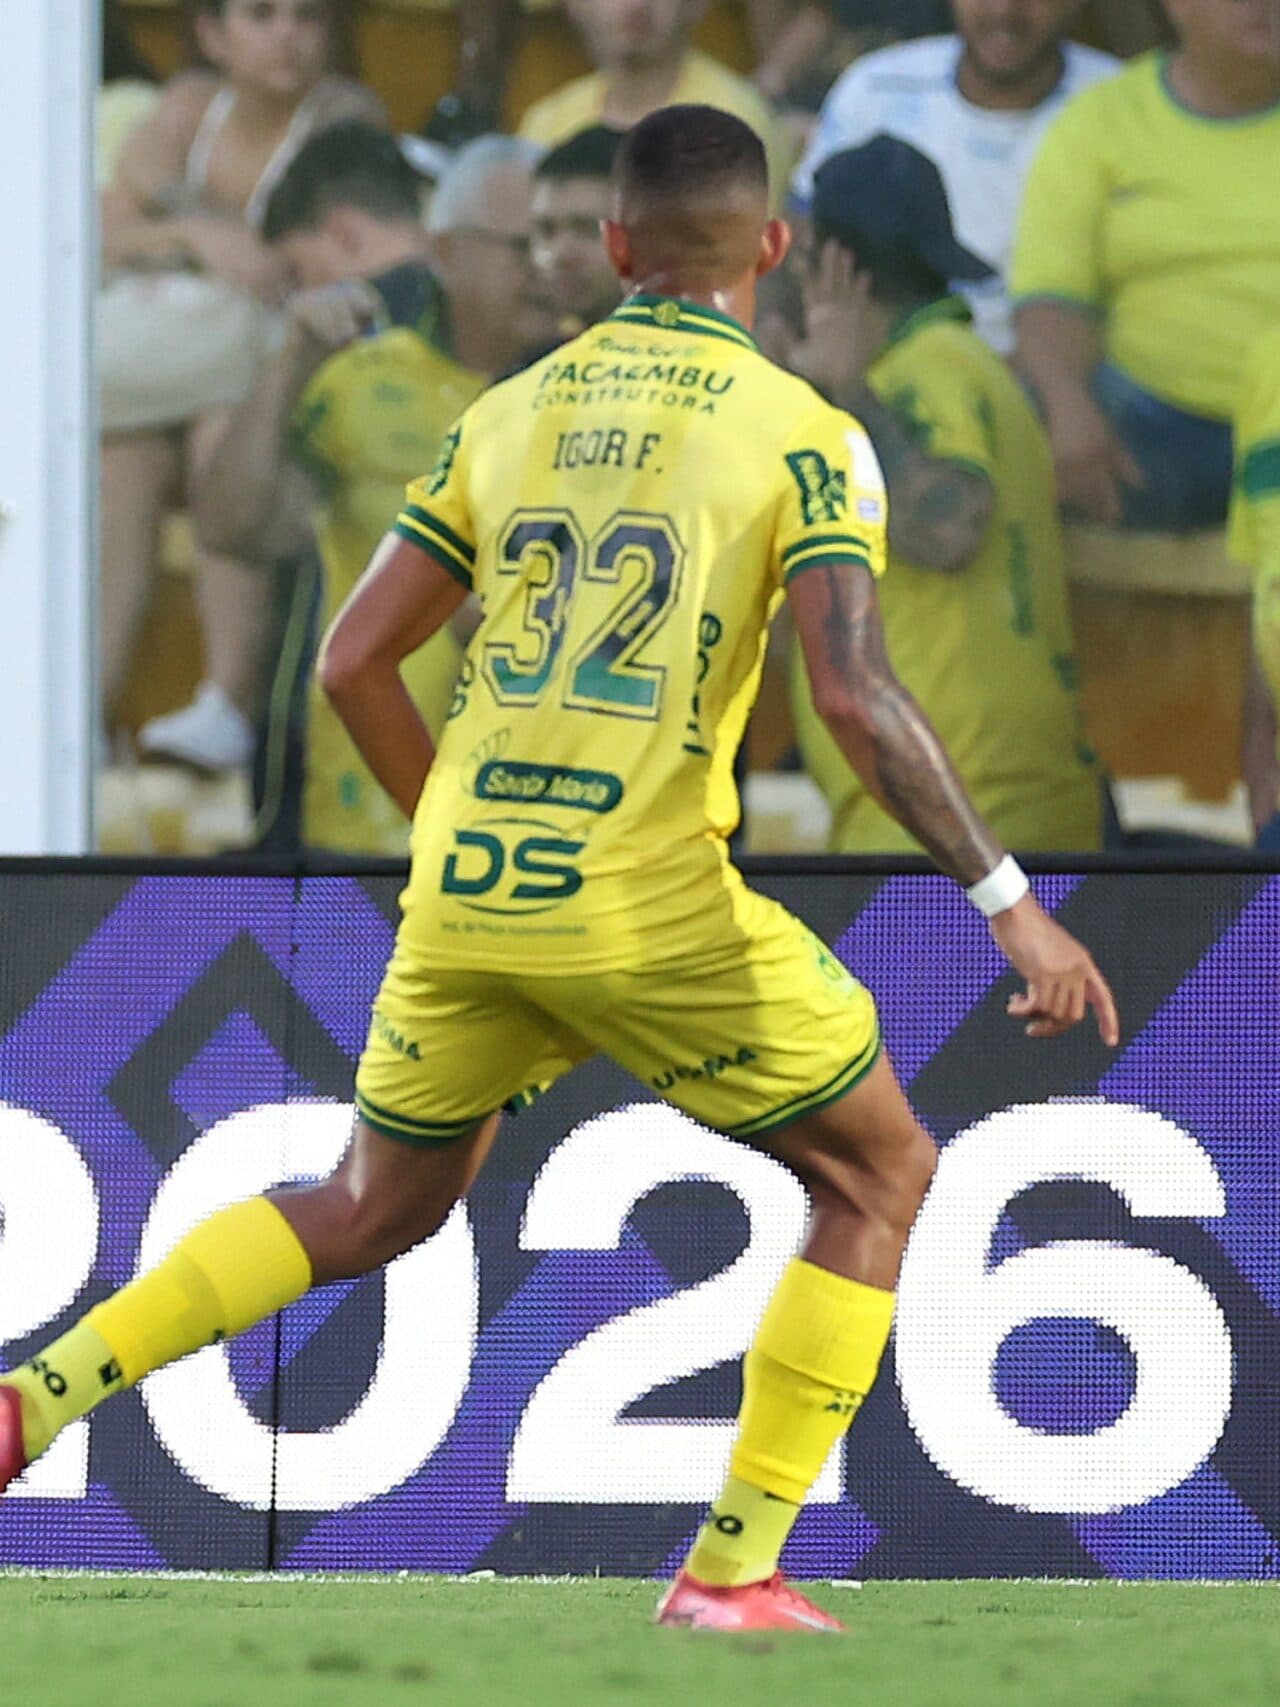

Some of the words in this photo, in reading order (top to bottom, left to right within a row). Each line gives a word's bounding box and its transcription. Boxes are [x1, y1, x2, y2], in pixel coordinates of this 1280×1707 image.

[540, 361, 735, 395] PACAEMBU
[533, 386, 716, 415] CONSTRUTORA
[552, 428, 627, 470] IGOR
[481, 506, 687, 721] 32
[440, 828, 588, 899] DS
